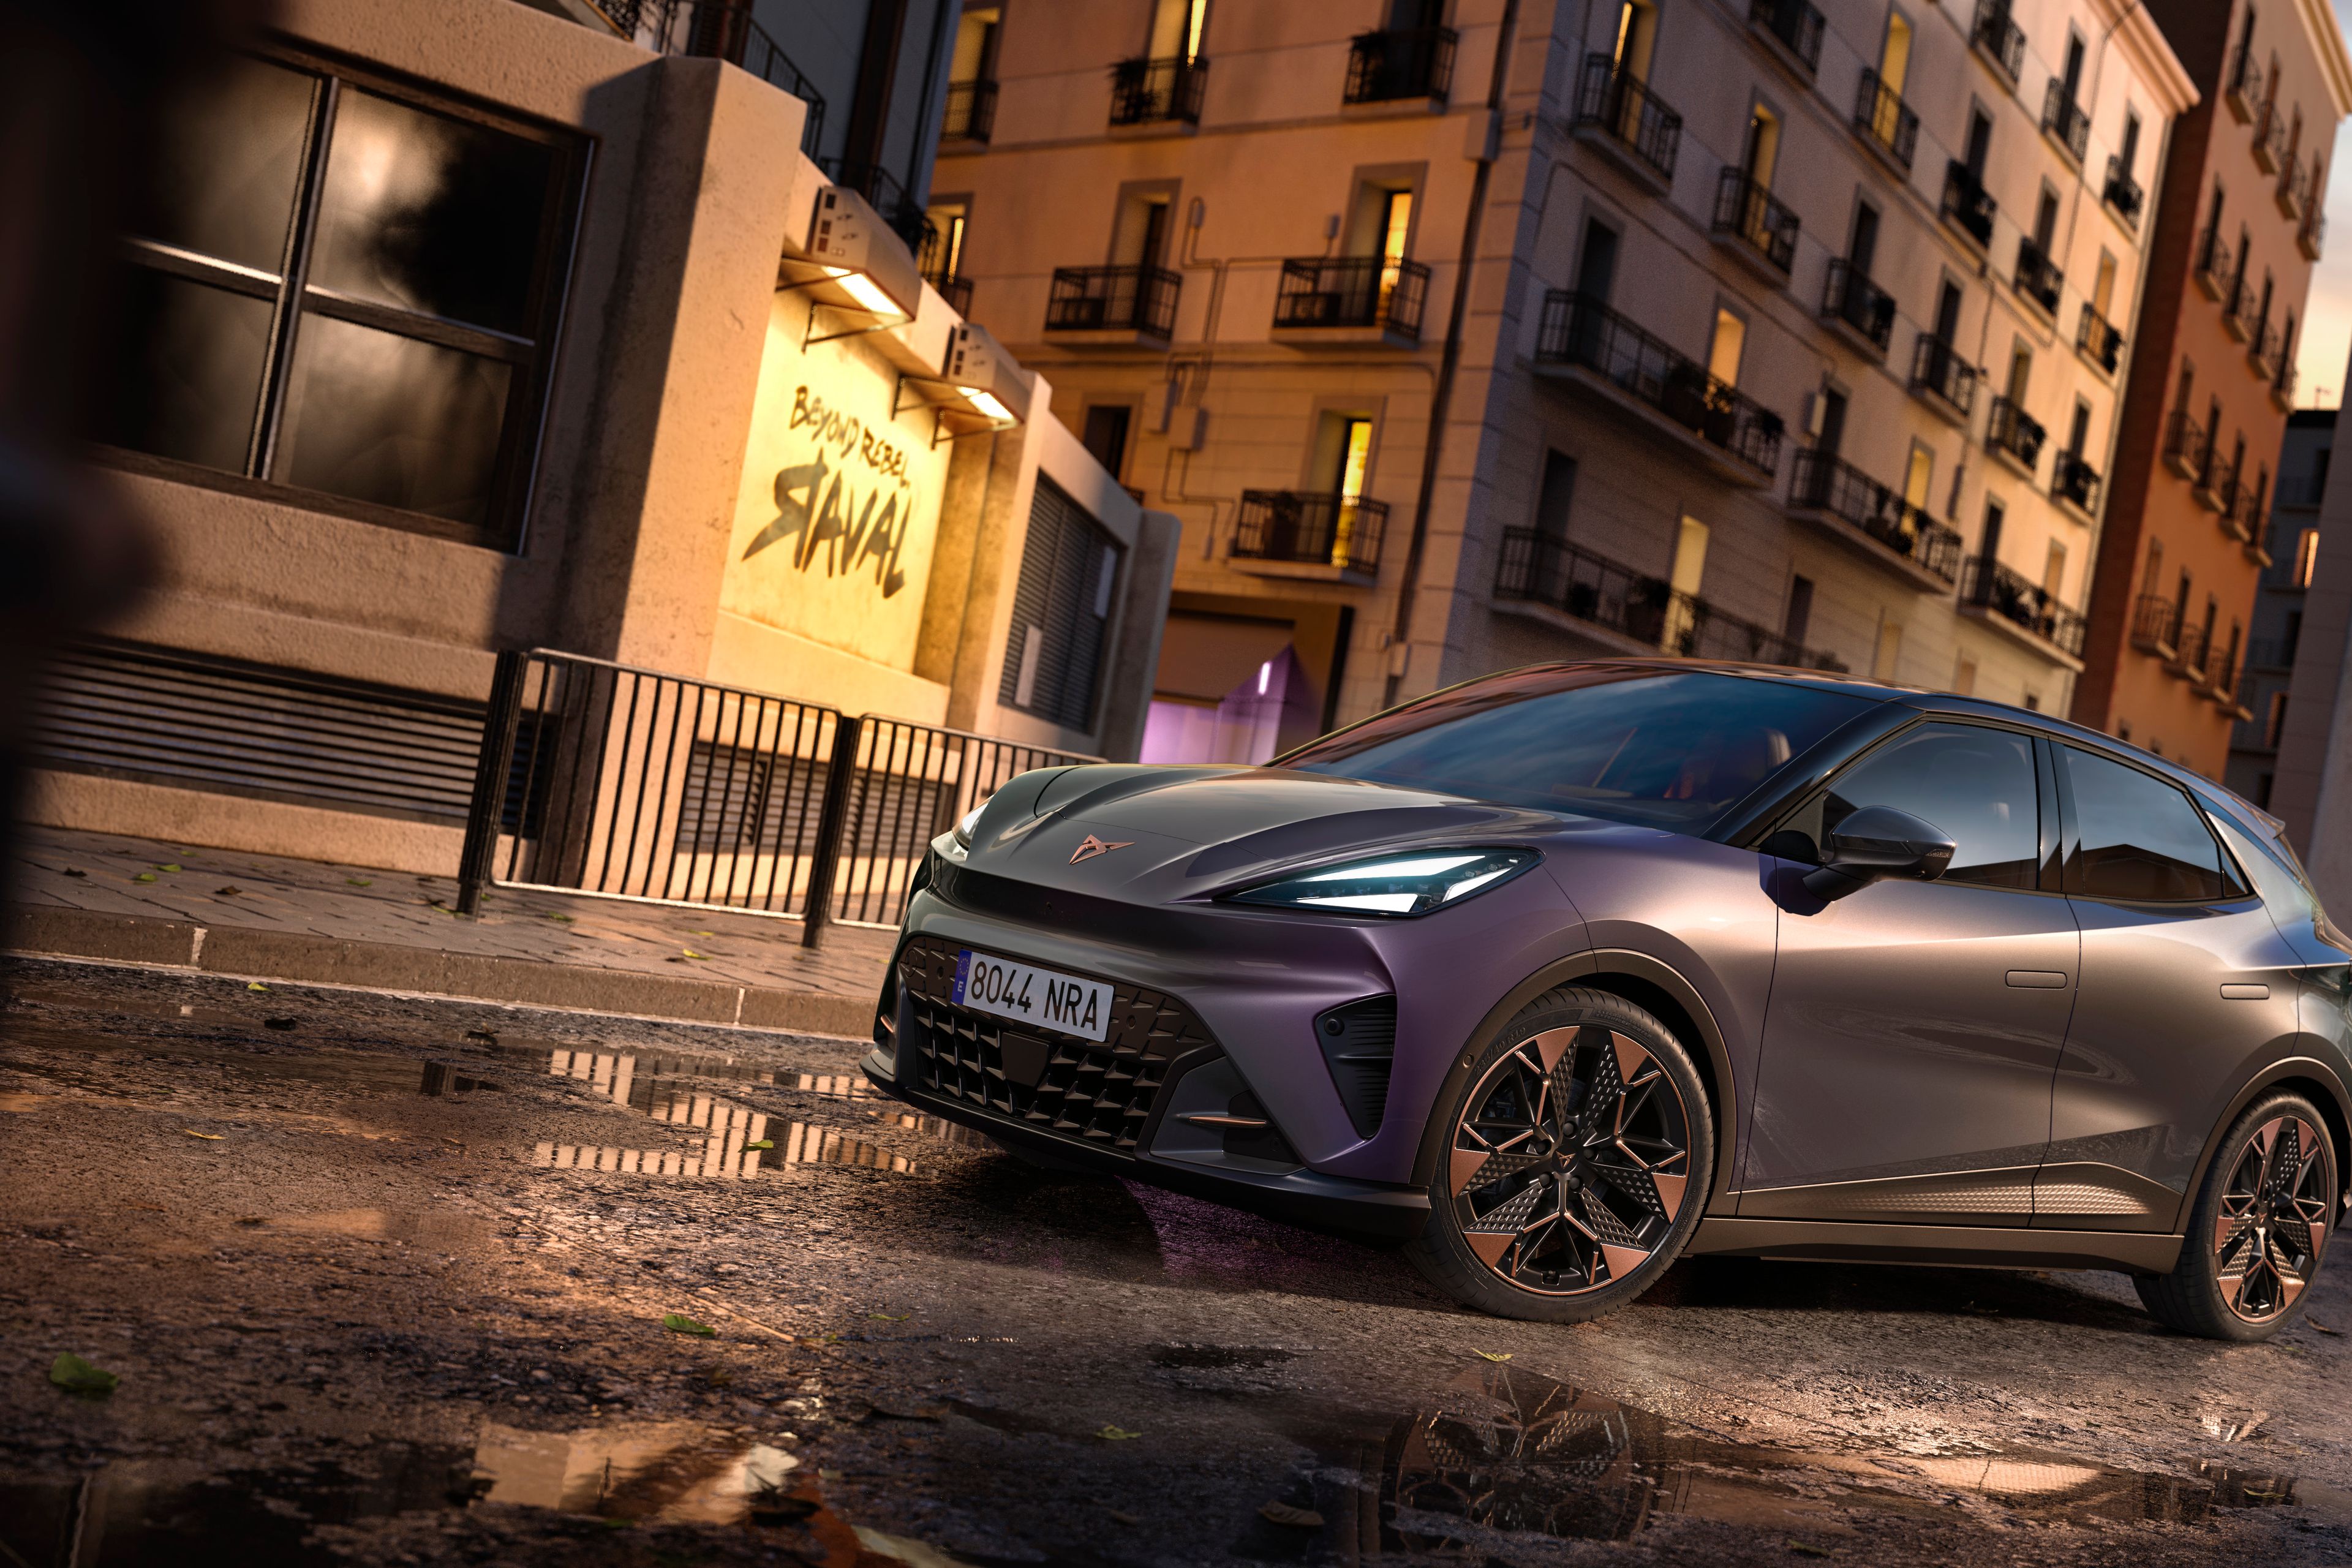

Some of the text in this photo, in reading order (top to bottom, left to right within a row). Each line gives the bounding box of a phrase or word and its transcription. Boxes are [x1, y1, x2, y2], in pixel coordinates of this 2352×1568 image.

[790, 386, 859, 459] BEYOND
[957, 981, 964, 993] E
[971, 961, 1098, 1031] 8044 NRA
